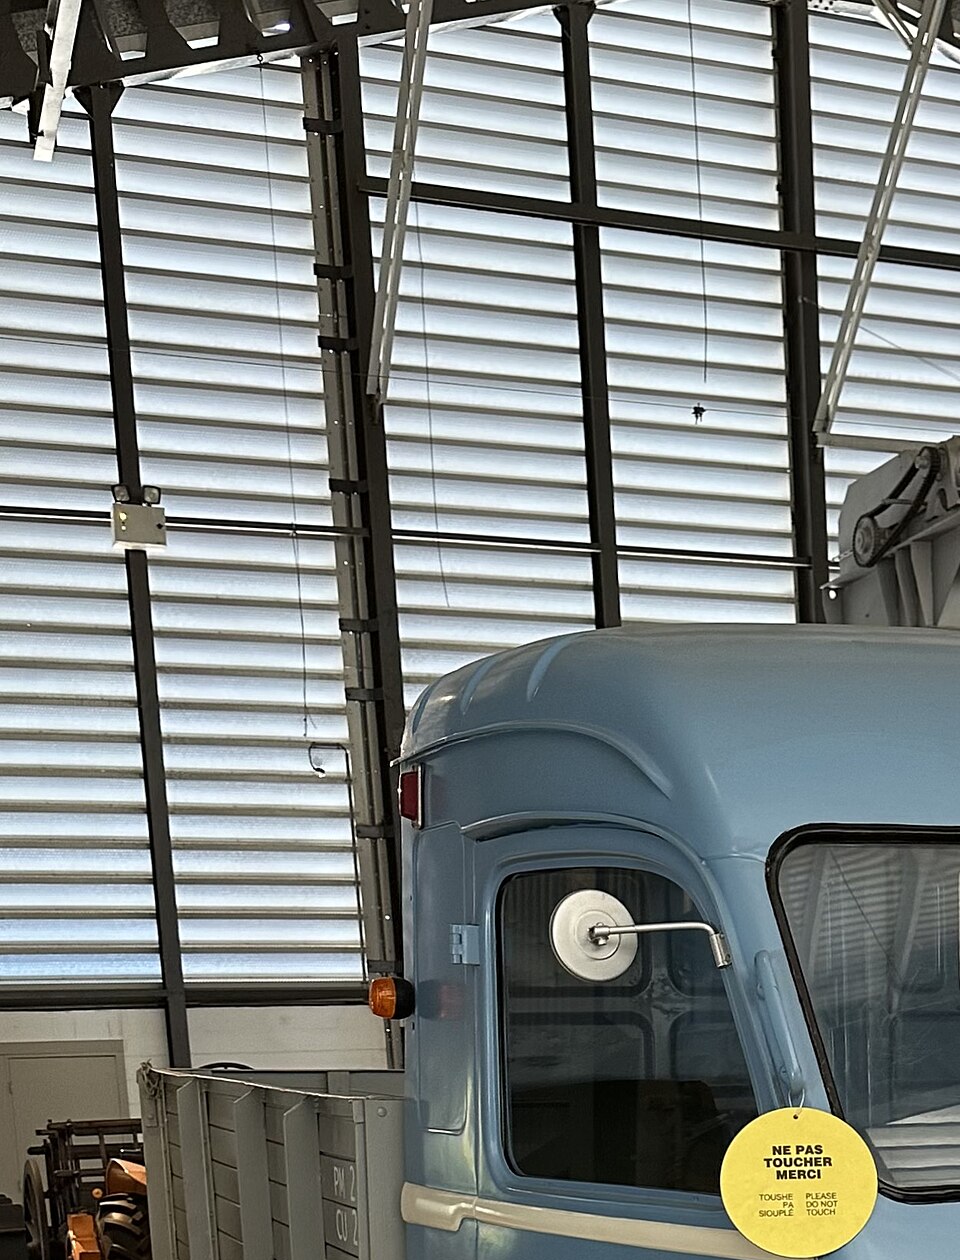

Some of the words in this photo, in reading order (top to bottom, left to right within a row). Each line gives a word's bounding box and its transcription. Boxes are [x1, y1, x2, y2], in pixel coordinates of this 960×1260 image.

[772, 1145, 791, 1155] NE
[795, 1145, 823, 1155] PAS
[763, 1157, 832, 1168] TOUCHER
[776, 1169, 821, 1180] MERCI
[759, 1193, 793, 1201] TOUSHE
[805, 1192, 837, 1200] PLEASE
[820, 1200, 838, 1208] NOT
[806, 1208, 836, 1216] TOUCH
[336, 1208, 347, 1242] CU
